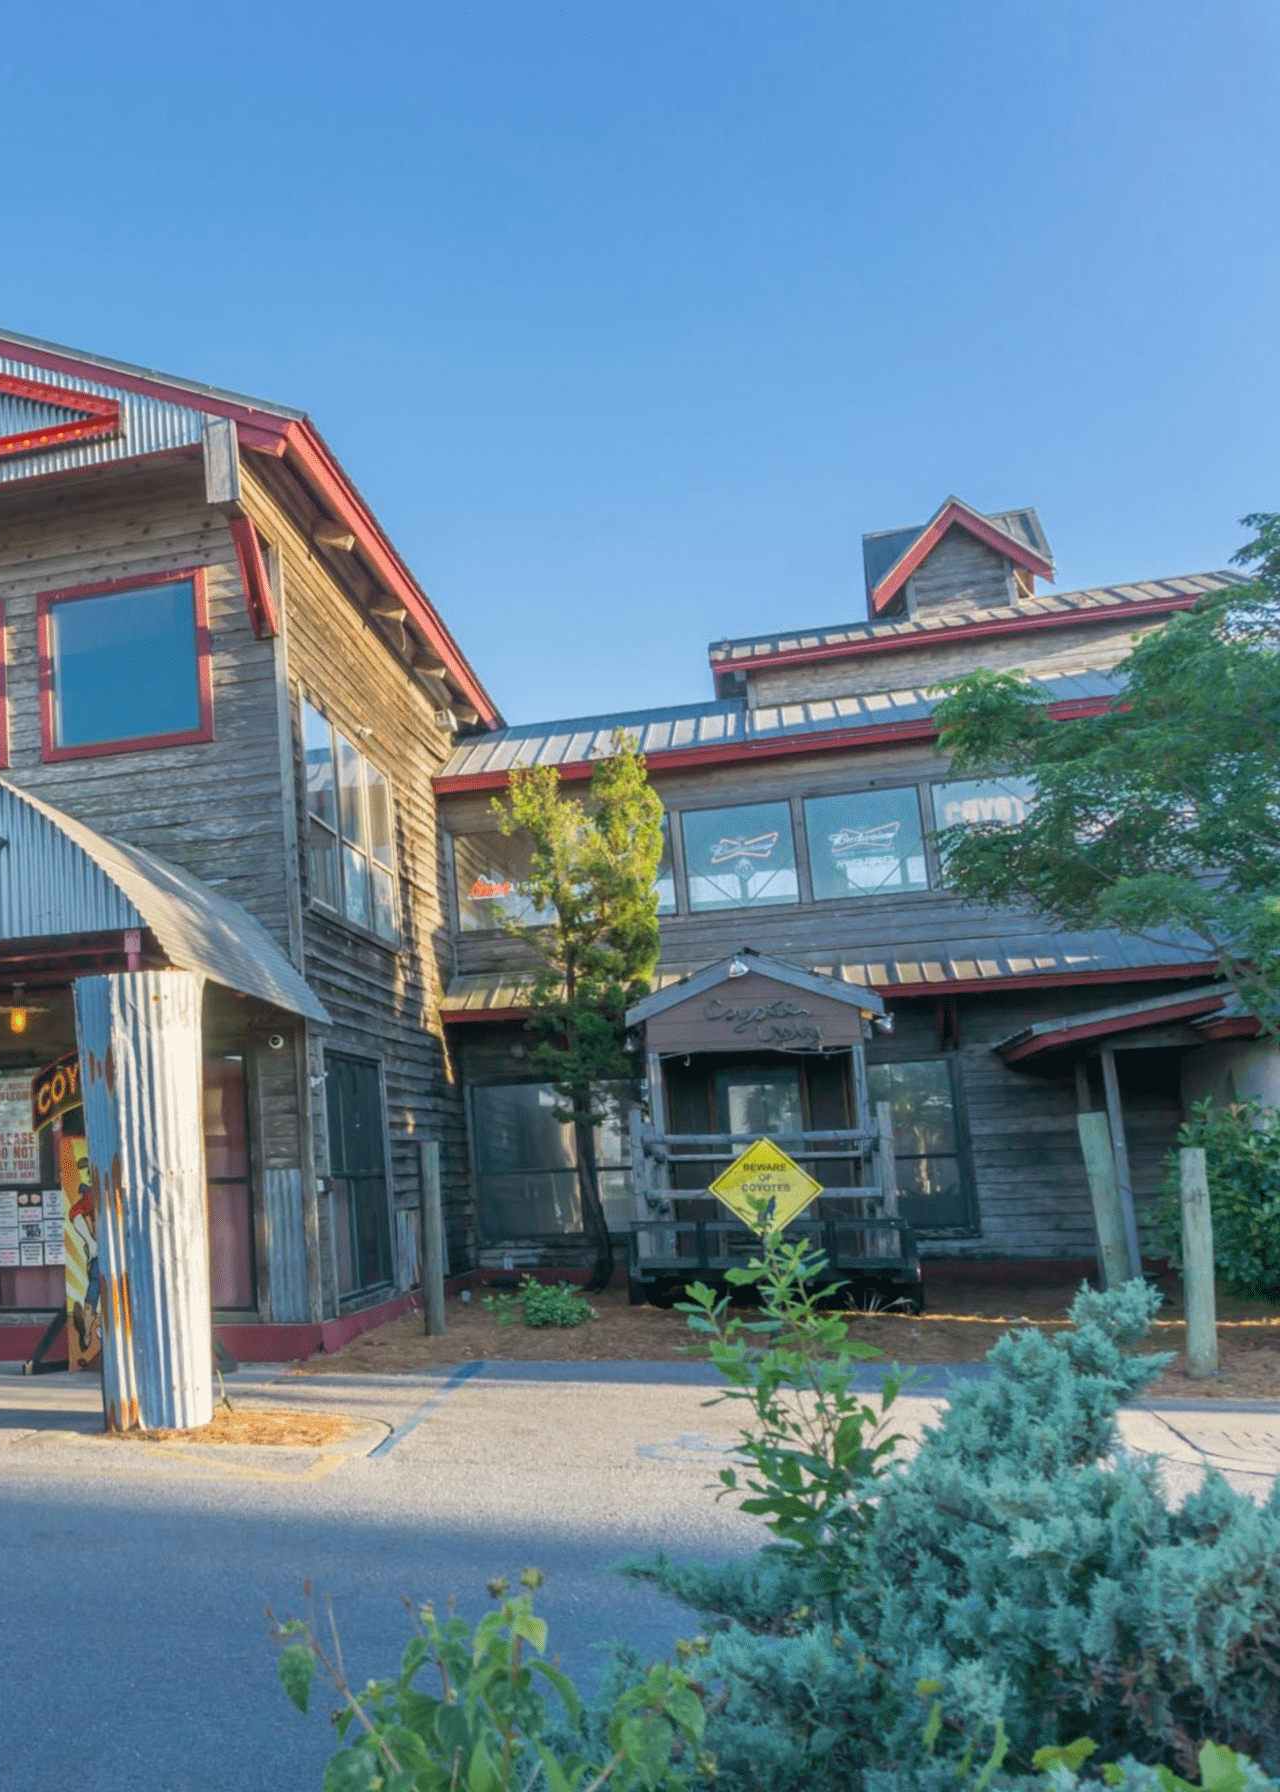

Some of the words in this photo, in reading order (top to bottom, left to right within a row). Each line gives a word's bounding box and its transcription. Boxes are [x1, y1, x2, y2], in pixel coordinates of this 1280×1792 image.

[37, 1062, 80, 1115] COY
[13, 1146, 34, 1159] NOT
[13, 1160, 35, 1171] YOUR
[743, 1163, 787, 1172] BEWARE
[758, 1174, 772, 1182] OF
[741, 1183, 792, 1192] COYOTES
